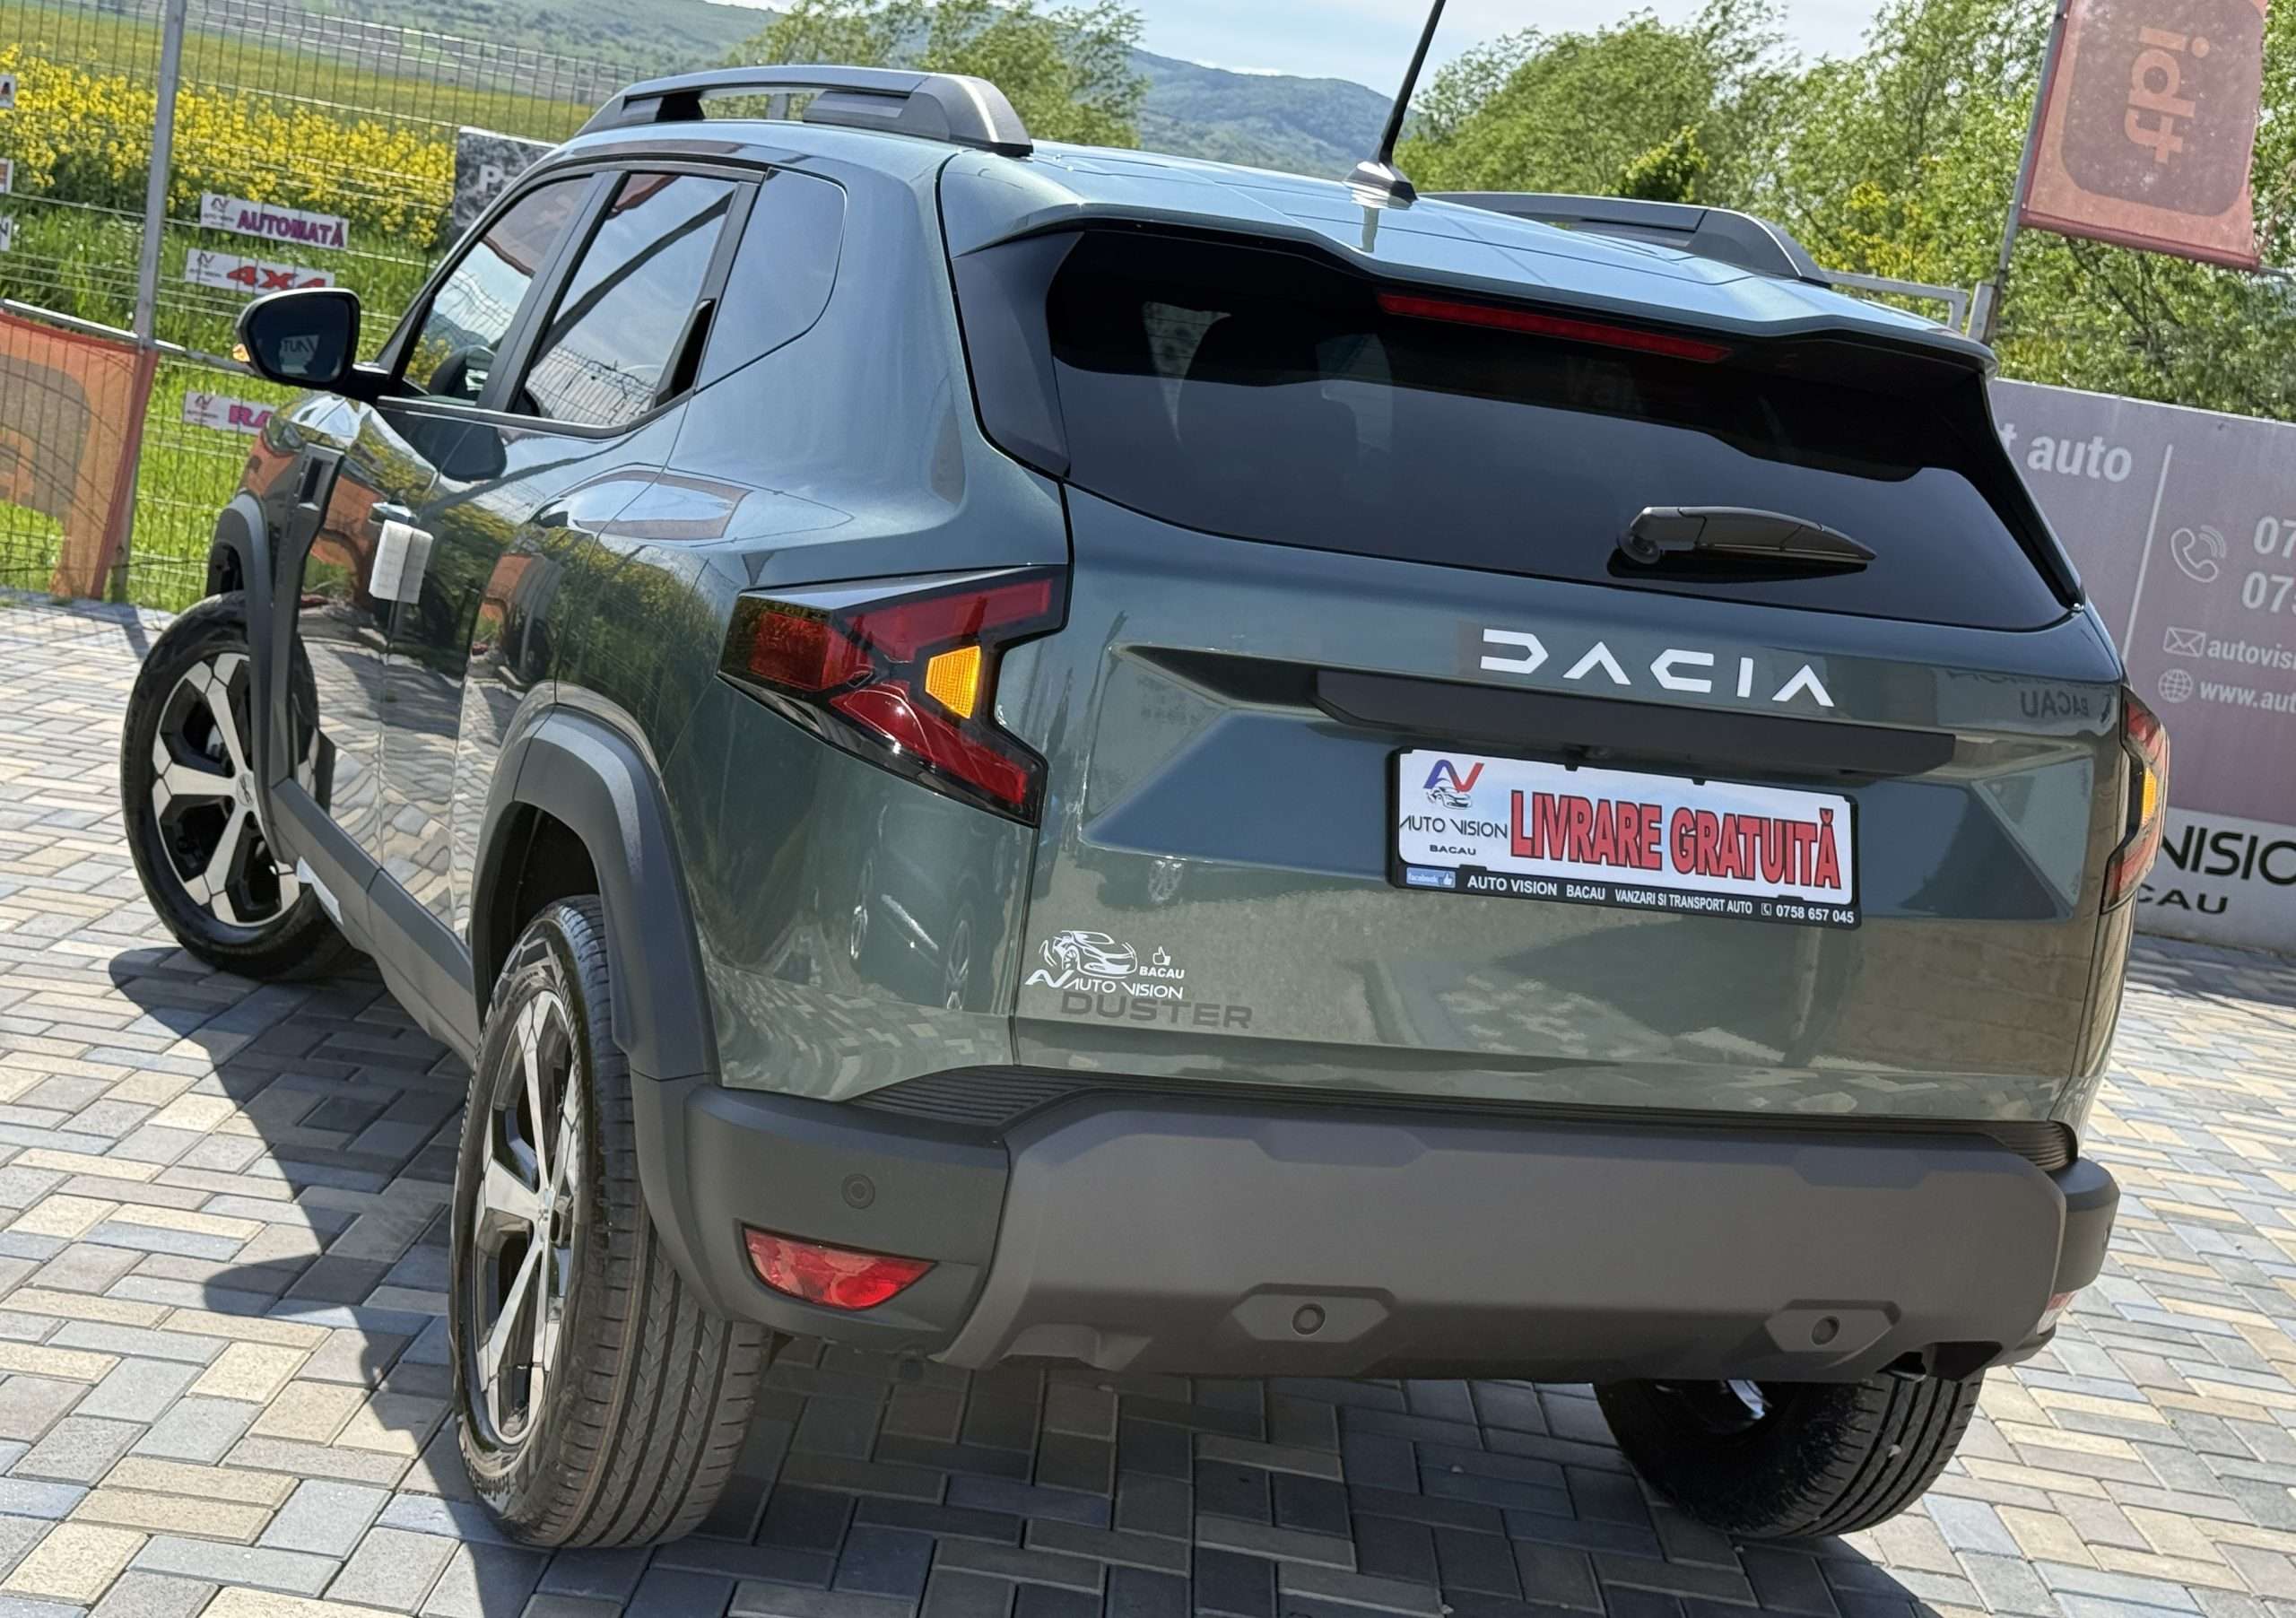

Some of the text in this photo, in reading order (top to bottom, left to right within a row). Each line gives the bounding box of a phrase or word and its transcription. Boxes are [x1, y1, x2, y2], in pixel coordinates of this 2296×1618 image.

[2027, 436, 2131, 483] auto
[2242, 571, 2296, 616] 07
[1480, 629, 1835, 707] DACIA
[1399, 815, 1508, 839] AUTO VISION
[1511, 789, 1841, 890] LIVRARE GRATUITĂ
[1430, 844, 1476, 855] BACAU
[1467, 874, 1854, 924] AUTO VISION BACAU VANZARI SI TRANSPORT AUTO 0758 657 045
[1064, 979, 1183, 999] AUTO VISION
[1139, 966, 1185, 979] BACAU
[1061, 991, 1253, 1029] DUSTER
